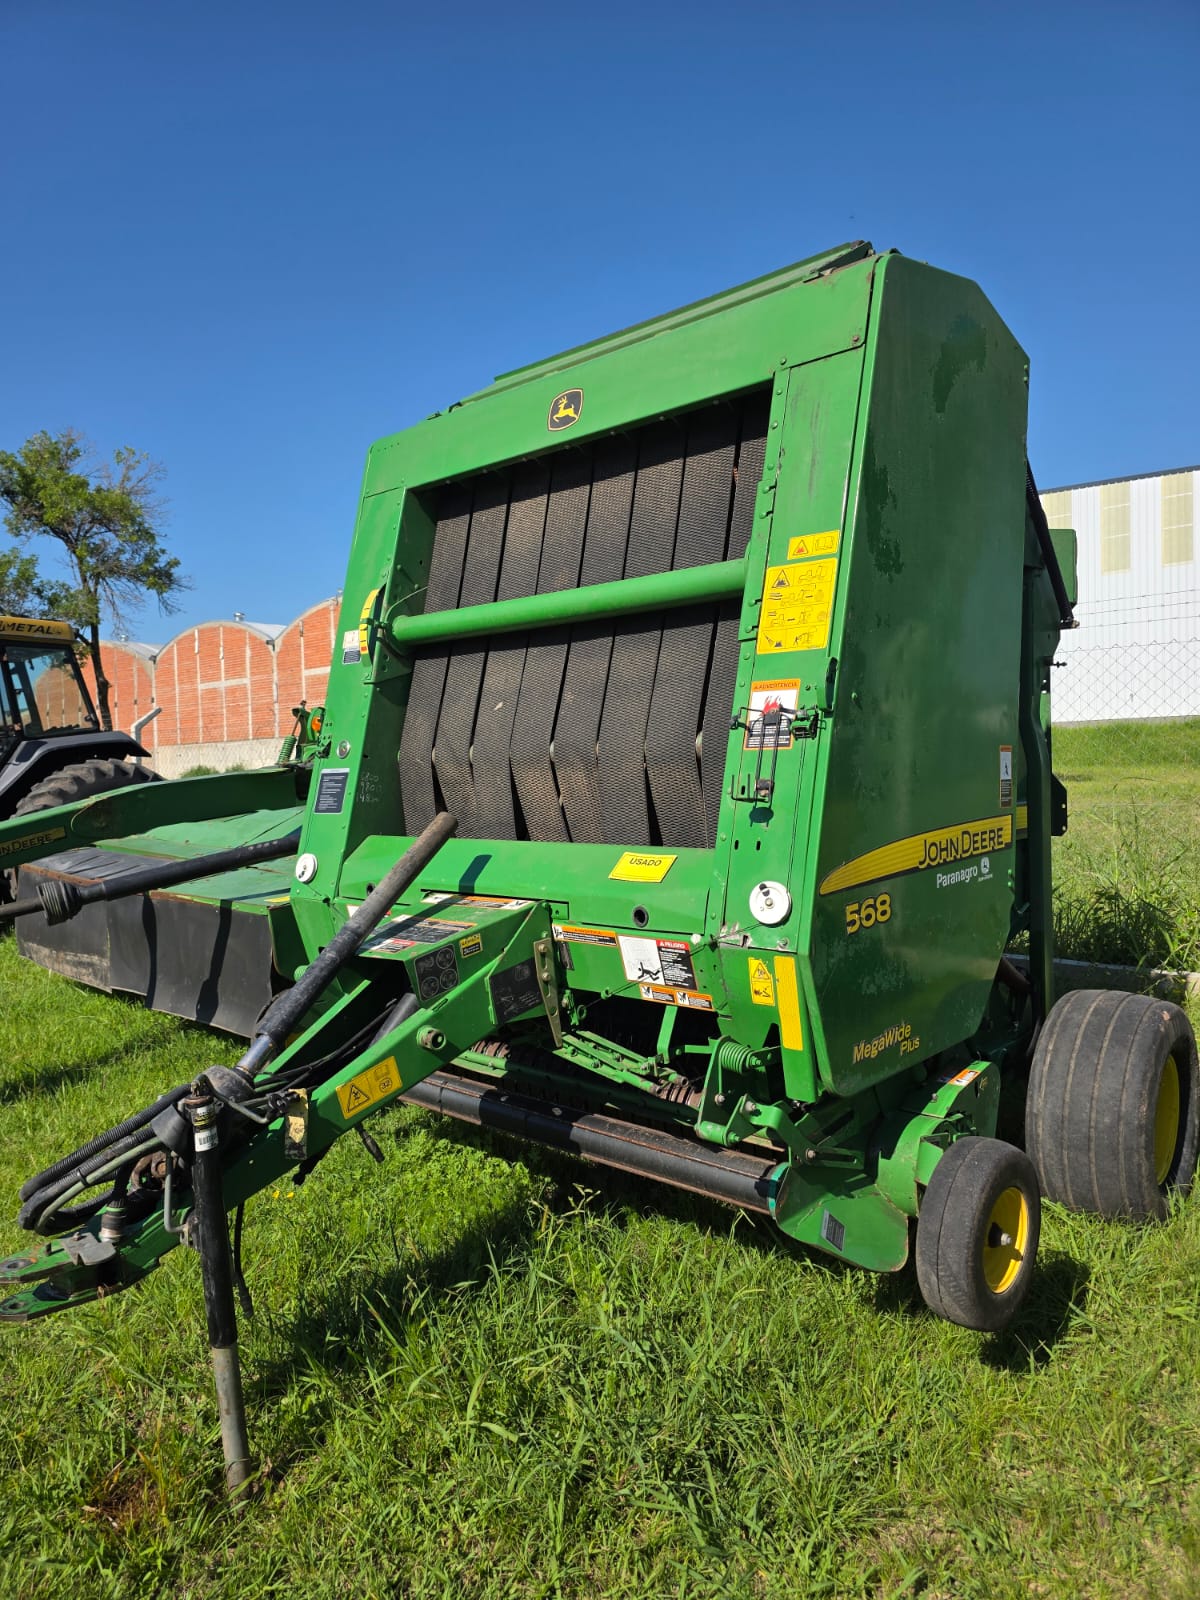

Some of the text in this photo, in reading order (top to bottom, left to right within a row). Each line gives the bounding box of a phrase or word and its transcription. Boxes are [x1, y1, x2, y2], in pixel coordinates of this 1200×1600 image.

[11, 833, 52, 851] DEERE
[918, 827, 1004, 866] JOHN DEERE
[629, 857, 662, 867] USADO
[936, 866, 978, 889] Paranagro
[846, 892, 891, 935] 568
[853, 1024, 911, 1064] MegaWide
[900, 1037, 920, 1056] Plus
